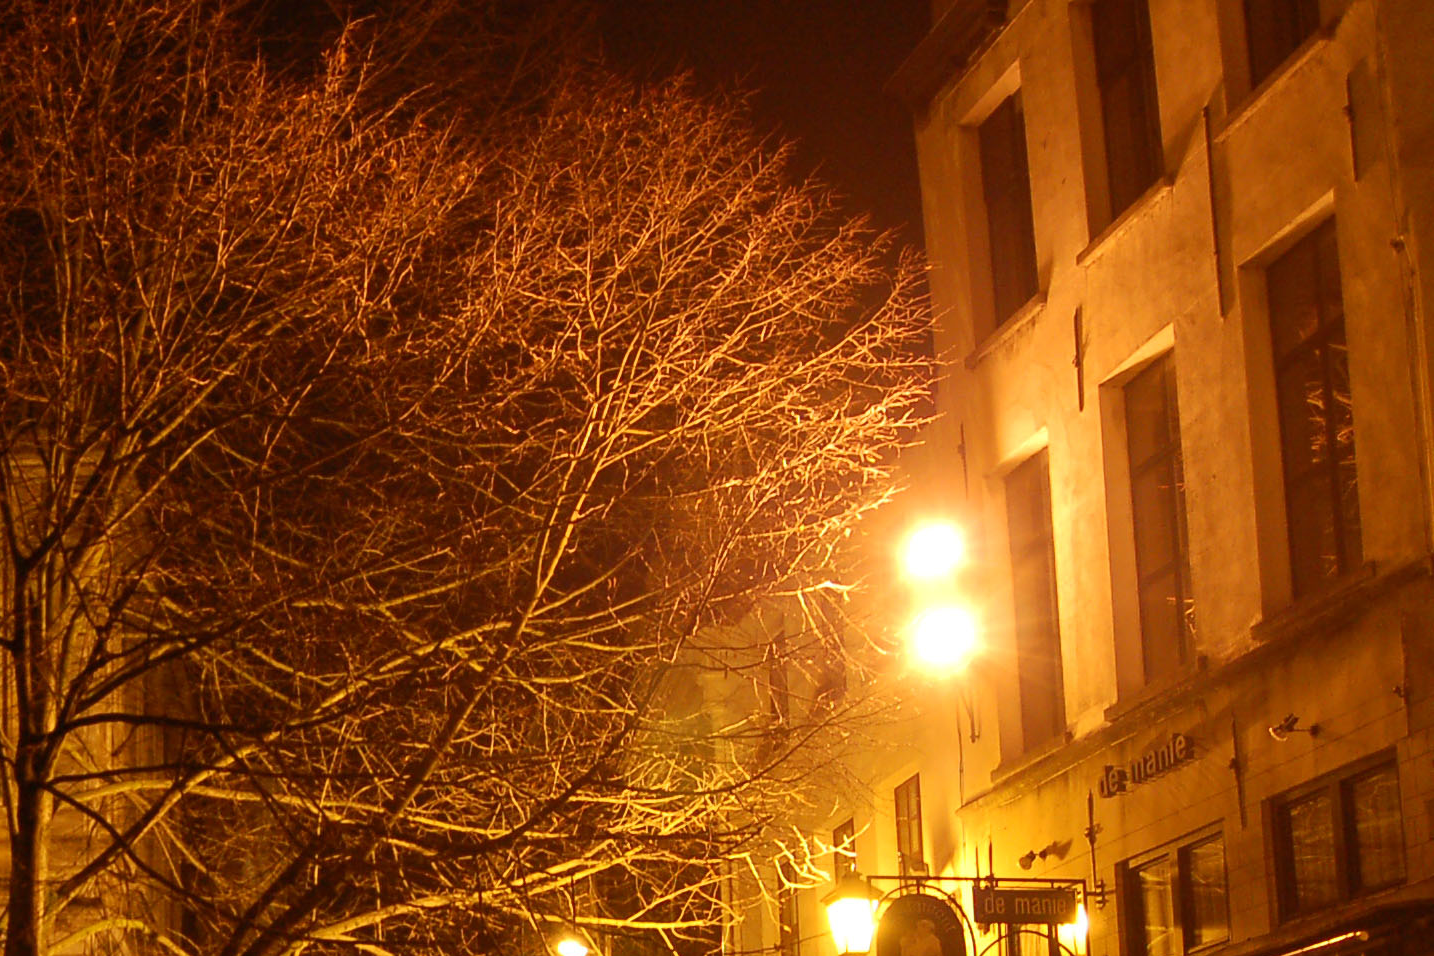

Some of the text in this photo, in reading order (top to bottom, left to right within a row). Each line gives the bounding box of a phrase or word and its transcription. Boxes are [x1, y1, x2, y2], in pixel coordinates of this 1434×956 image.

[1099, 734, 1186, 797] de manie
[985, 892, 1066, 915] de manie
